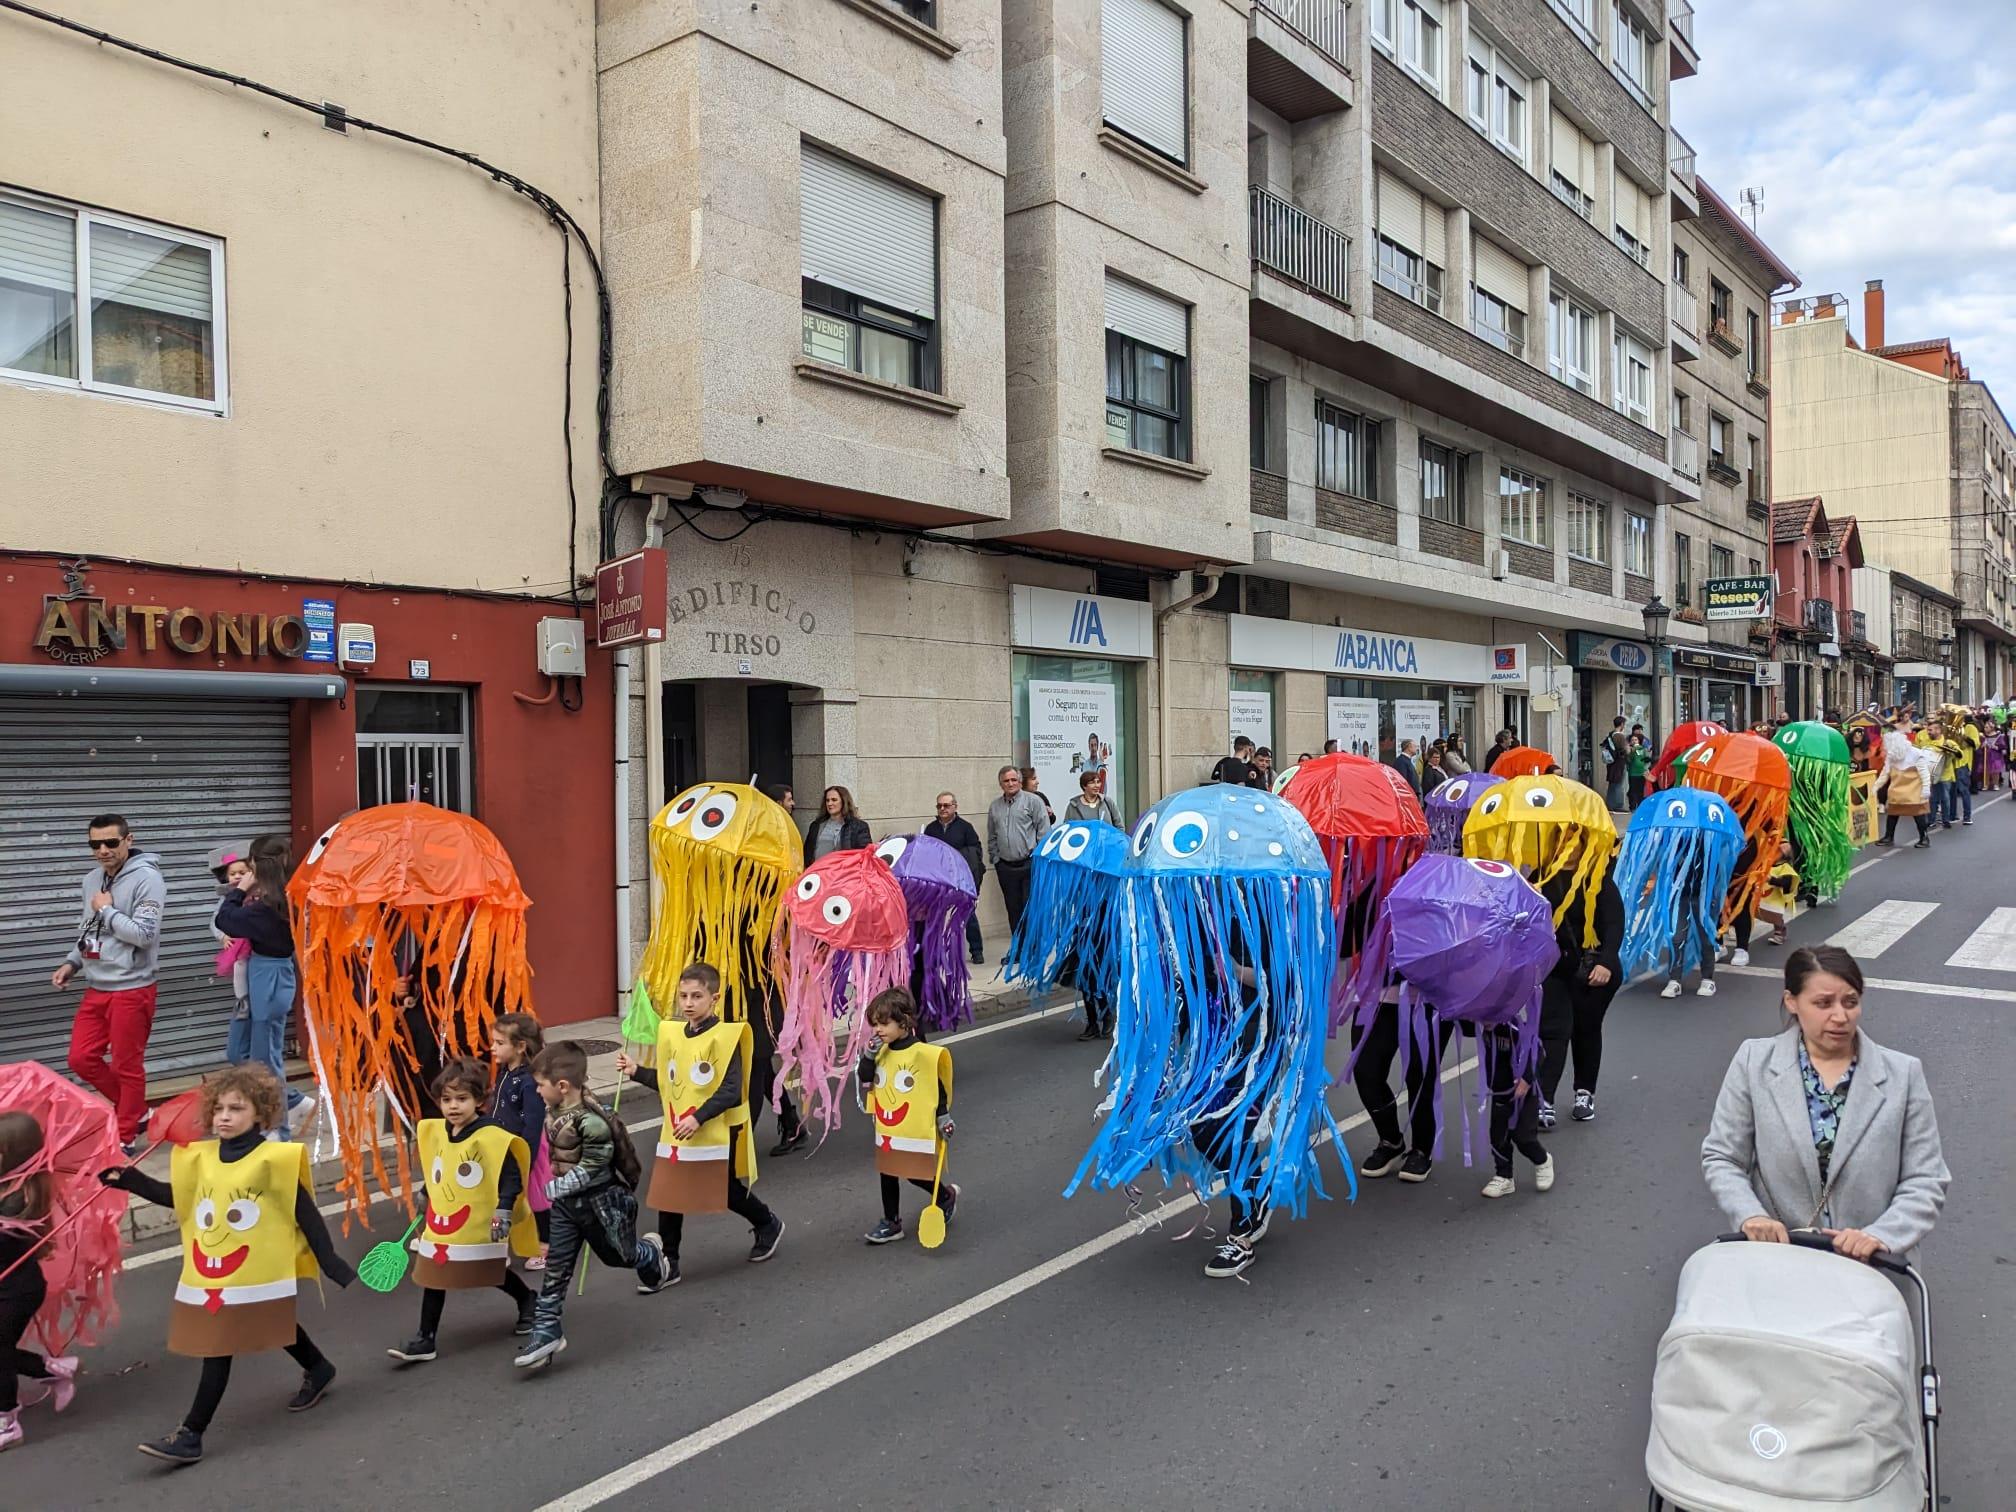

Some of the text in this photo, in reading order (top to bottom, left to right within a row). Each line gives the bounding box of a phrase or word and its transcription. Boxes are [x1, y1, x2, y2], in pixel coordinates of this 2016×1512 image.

[803, 315, 845, 339] SE VENDE
[1107, 412, 1127, 428] VENDE
[731, 543, 756, 567] 75
[615, 594, 642, 617] ANTONIO
[668, 581, 816, 635] EDIFICIO
[1709, 592, 1759, 604] Resero
[1708, 608, 1729, 617] Abierto
[33, 600, 308, 658] ANTONIO
[705, 631, 781, 656] TIRSO
[45, 644, 110, 665] JOYERIAS
[1620, 645, 1639, 667] PEPA
[415, 667, 426, 675] 73
[1048, 699, 1055, 709] O
[1055, 698, 1078, 712] Seguro
[1081, 712, 1100, 726] Fogar
